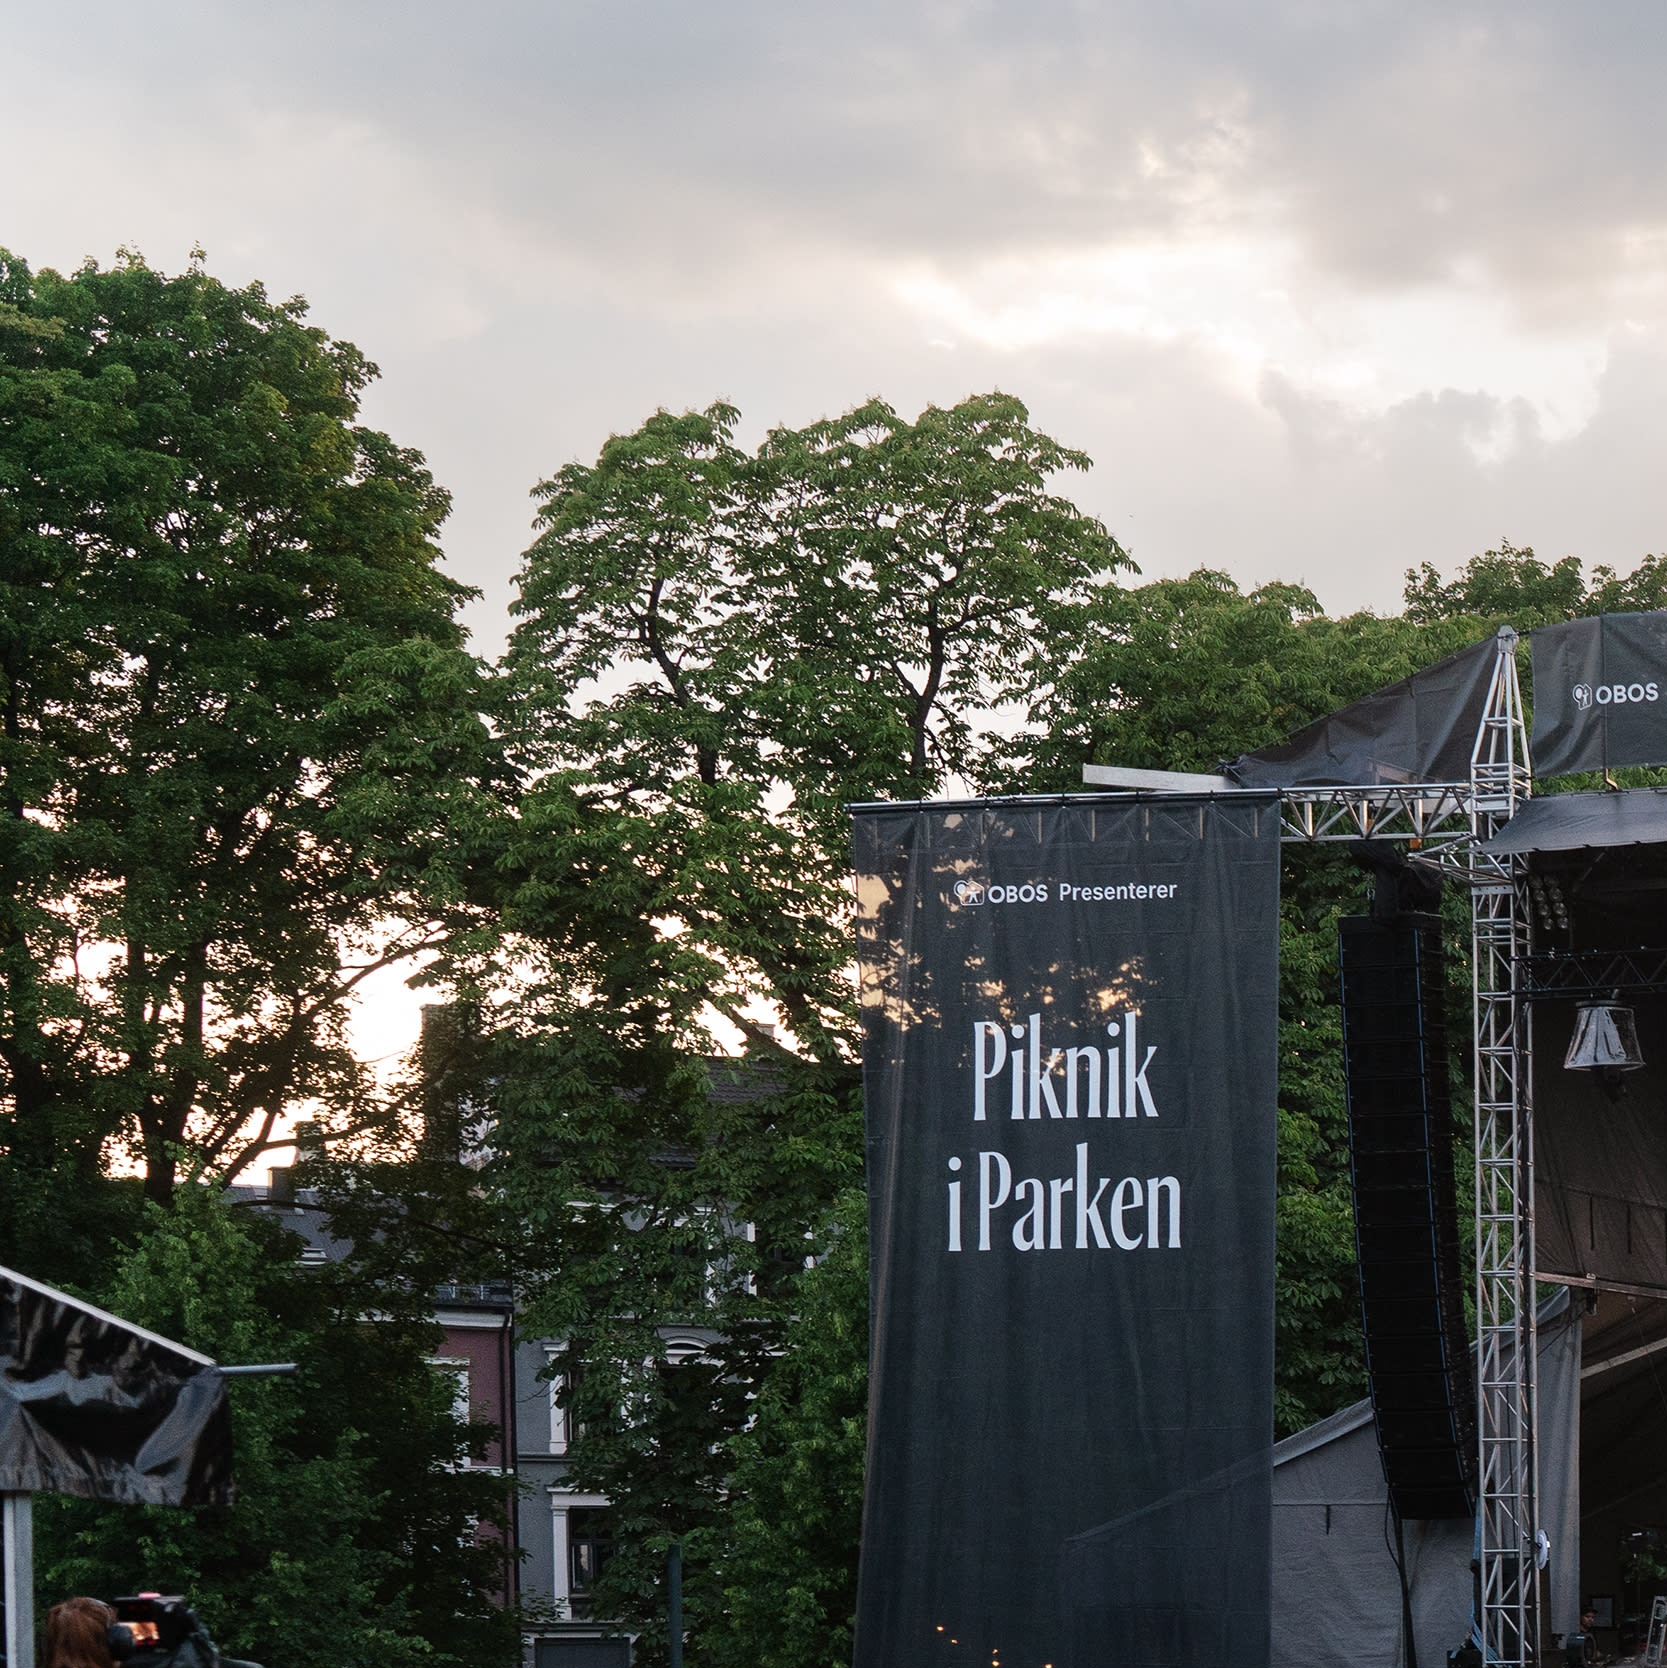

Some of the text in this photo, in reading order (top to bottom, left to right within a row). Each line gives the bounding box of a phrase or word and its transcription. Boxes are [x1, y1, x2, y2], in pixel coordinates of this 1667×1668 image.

[1595, 682, 1659, 705] OBOS
[988, 882, 1177, 904] OBOS Presenterer
[973, 1010, 1159, 1121] Piknik
[948, 1142, 1182, 1252] i Parken
